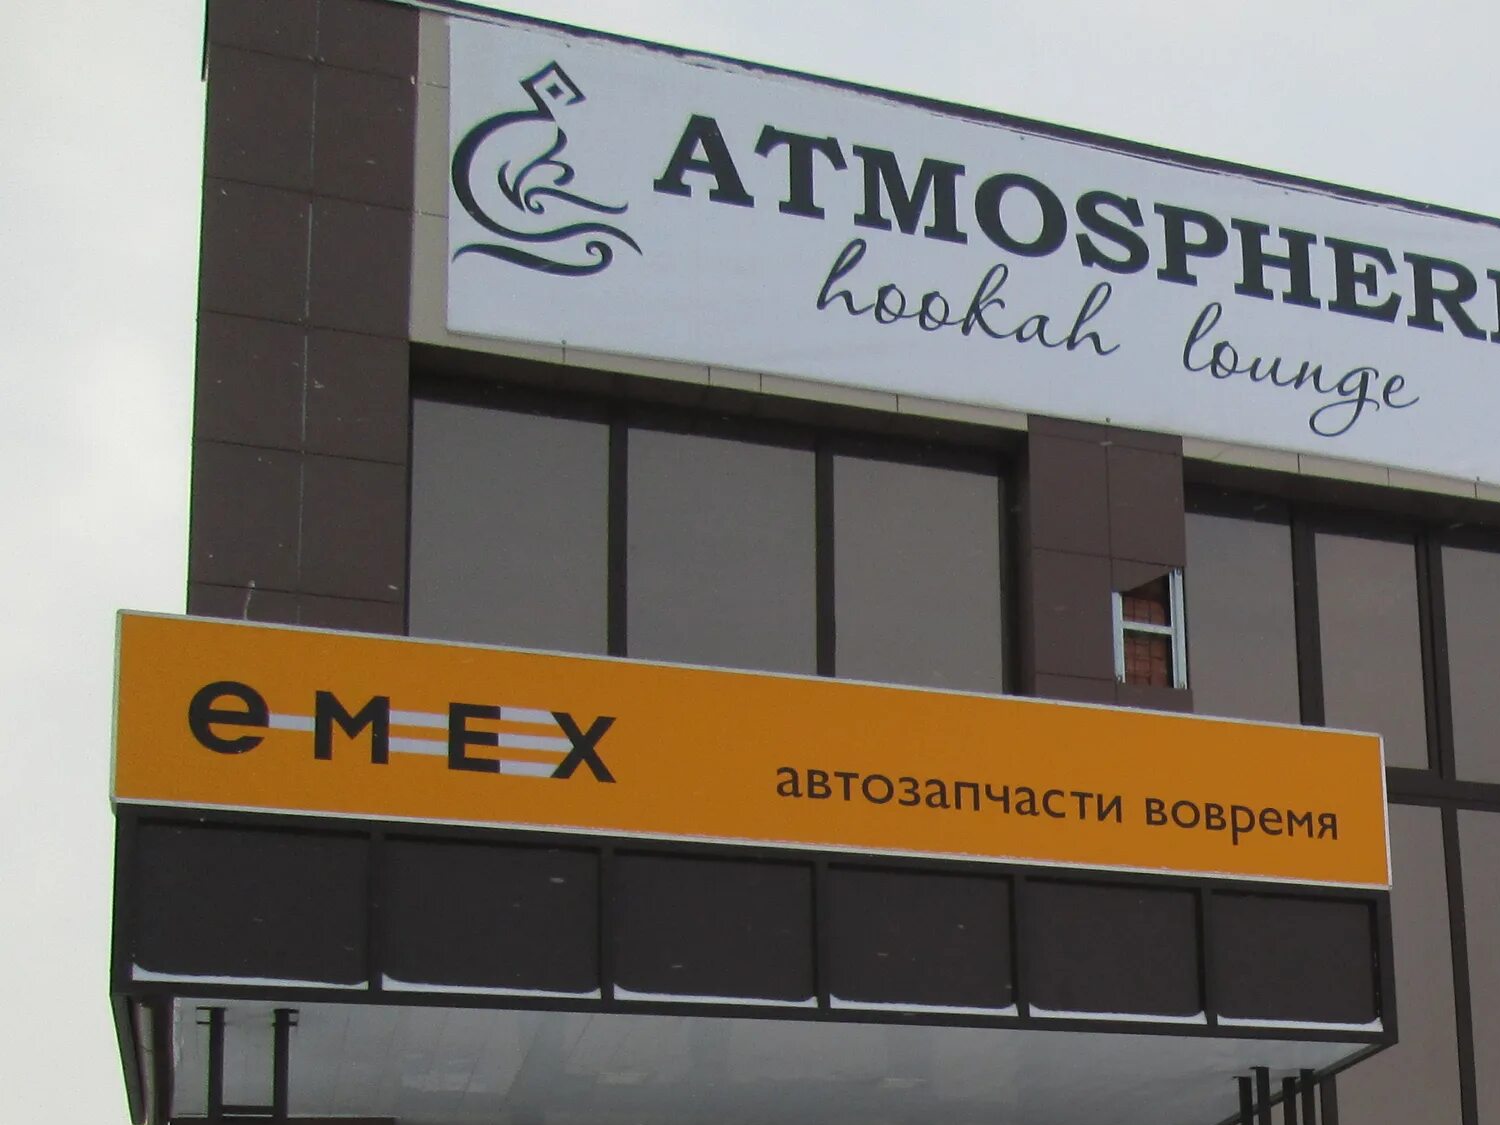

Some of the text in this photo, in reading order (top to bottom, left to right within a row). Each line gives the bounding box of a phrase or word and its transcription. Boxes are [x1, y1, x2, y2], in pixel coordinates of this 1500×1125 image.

[817, 238, 1420, 438] hookah lounge
[775, 762, 1339, 844] автозапчасти вовремя
